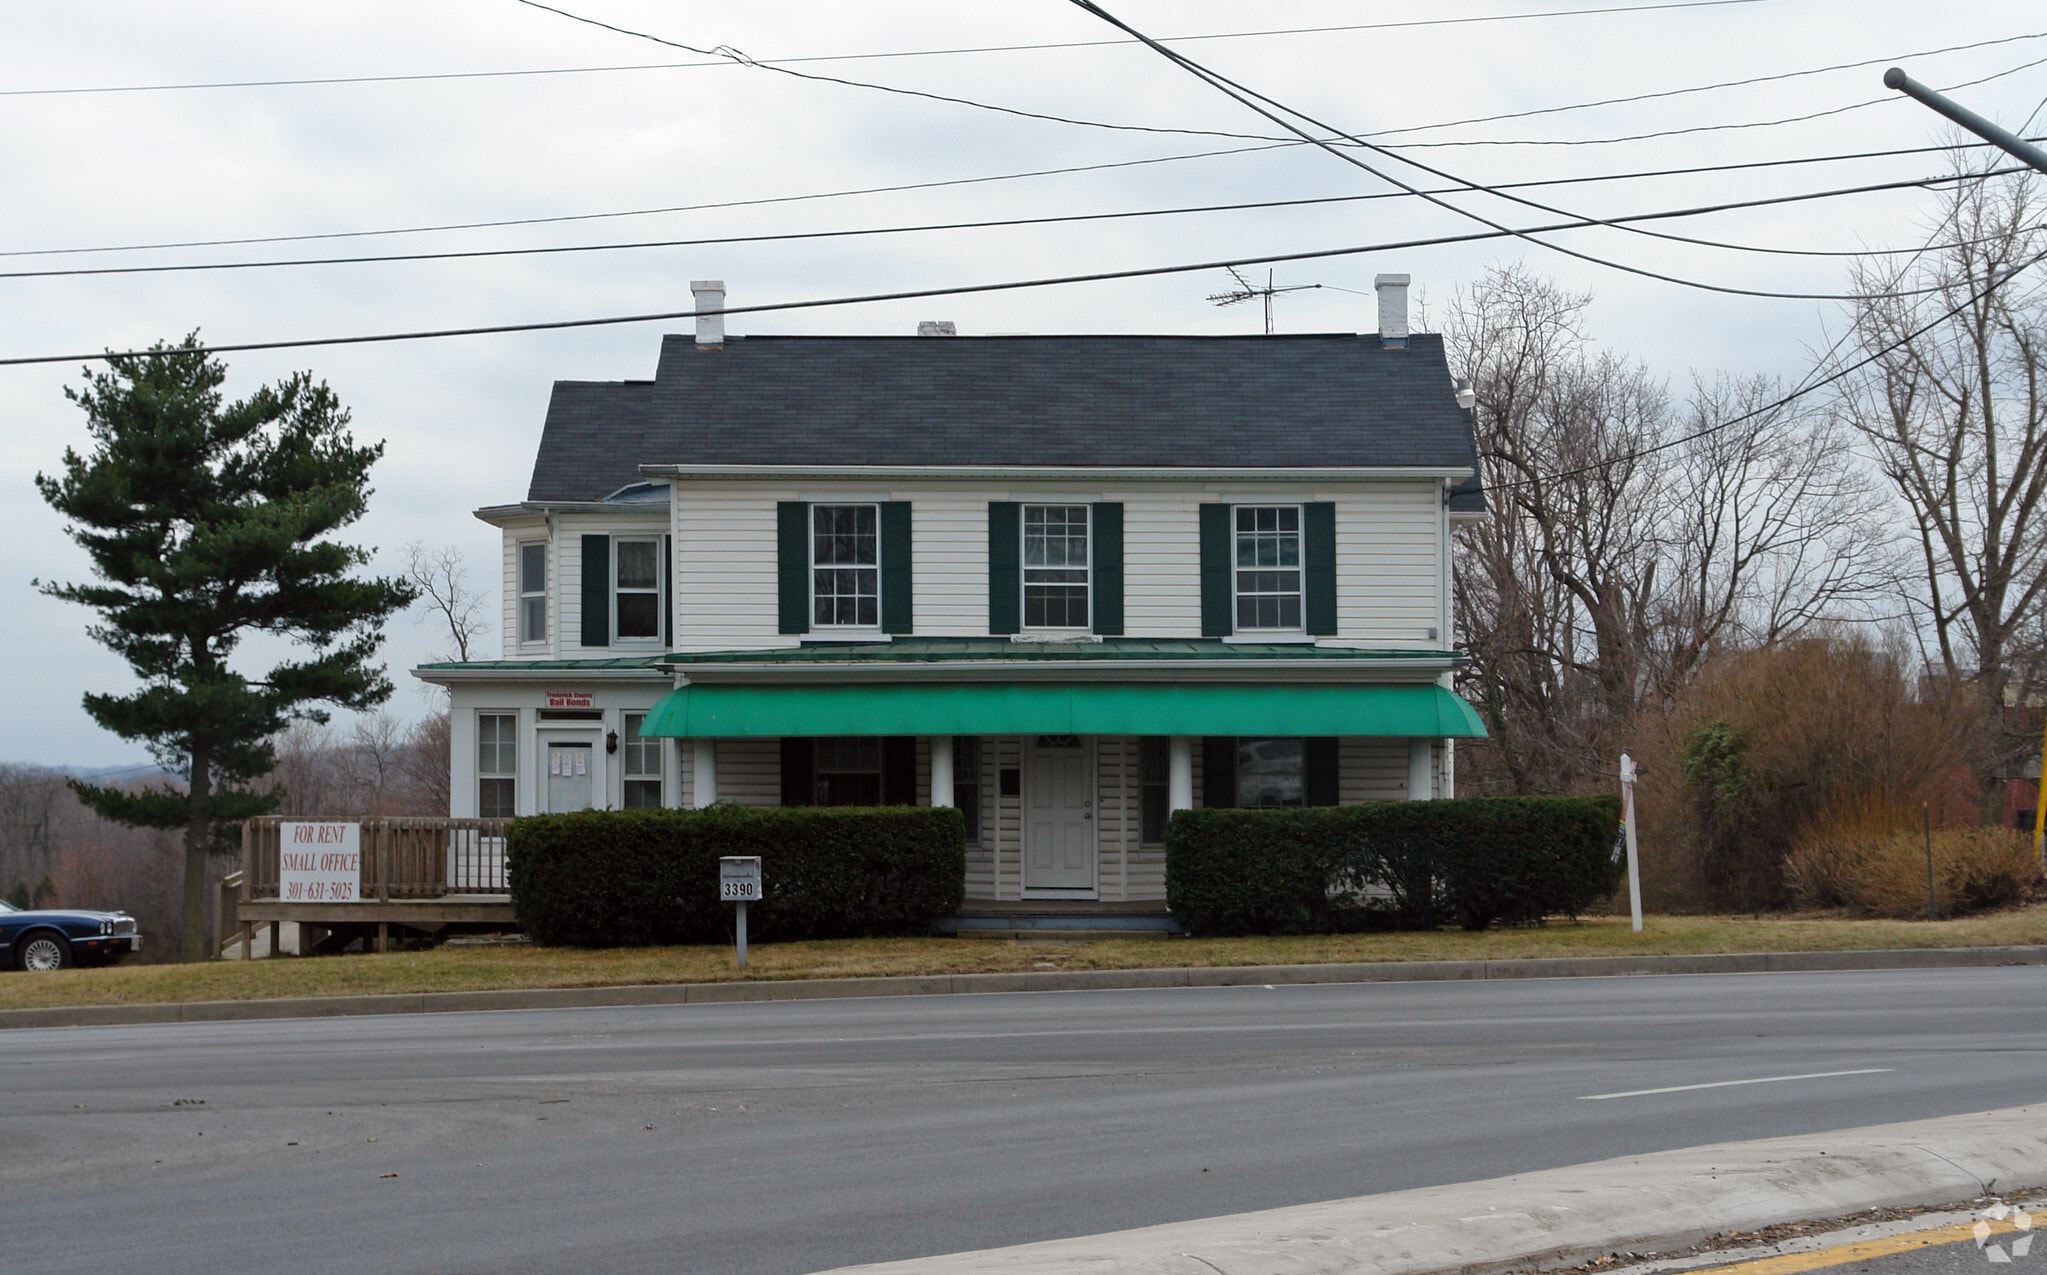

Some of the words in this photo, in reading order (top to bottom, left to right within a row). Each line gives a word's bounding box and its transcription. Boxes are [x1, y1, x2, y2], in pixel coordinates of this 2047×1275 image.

[549, 698, 564, 706] Bail
[566, 698, 591, 706] Bonds
[293, 825, 314, 844] FOR
[317, 825, 347, 844] RENT
[282, 853, 317, 872] SMALL
[320, 853, 359, 872] OFFICE
[286, 881, 353, 900] 301-631-5025
[724, 882, 753, 896] 3390
